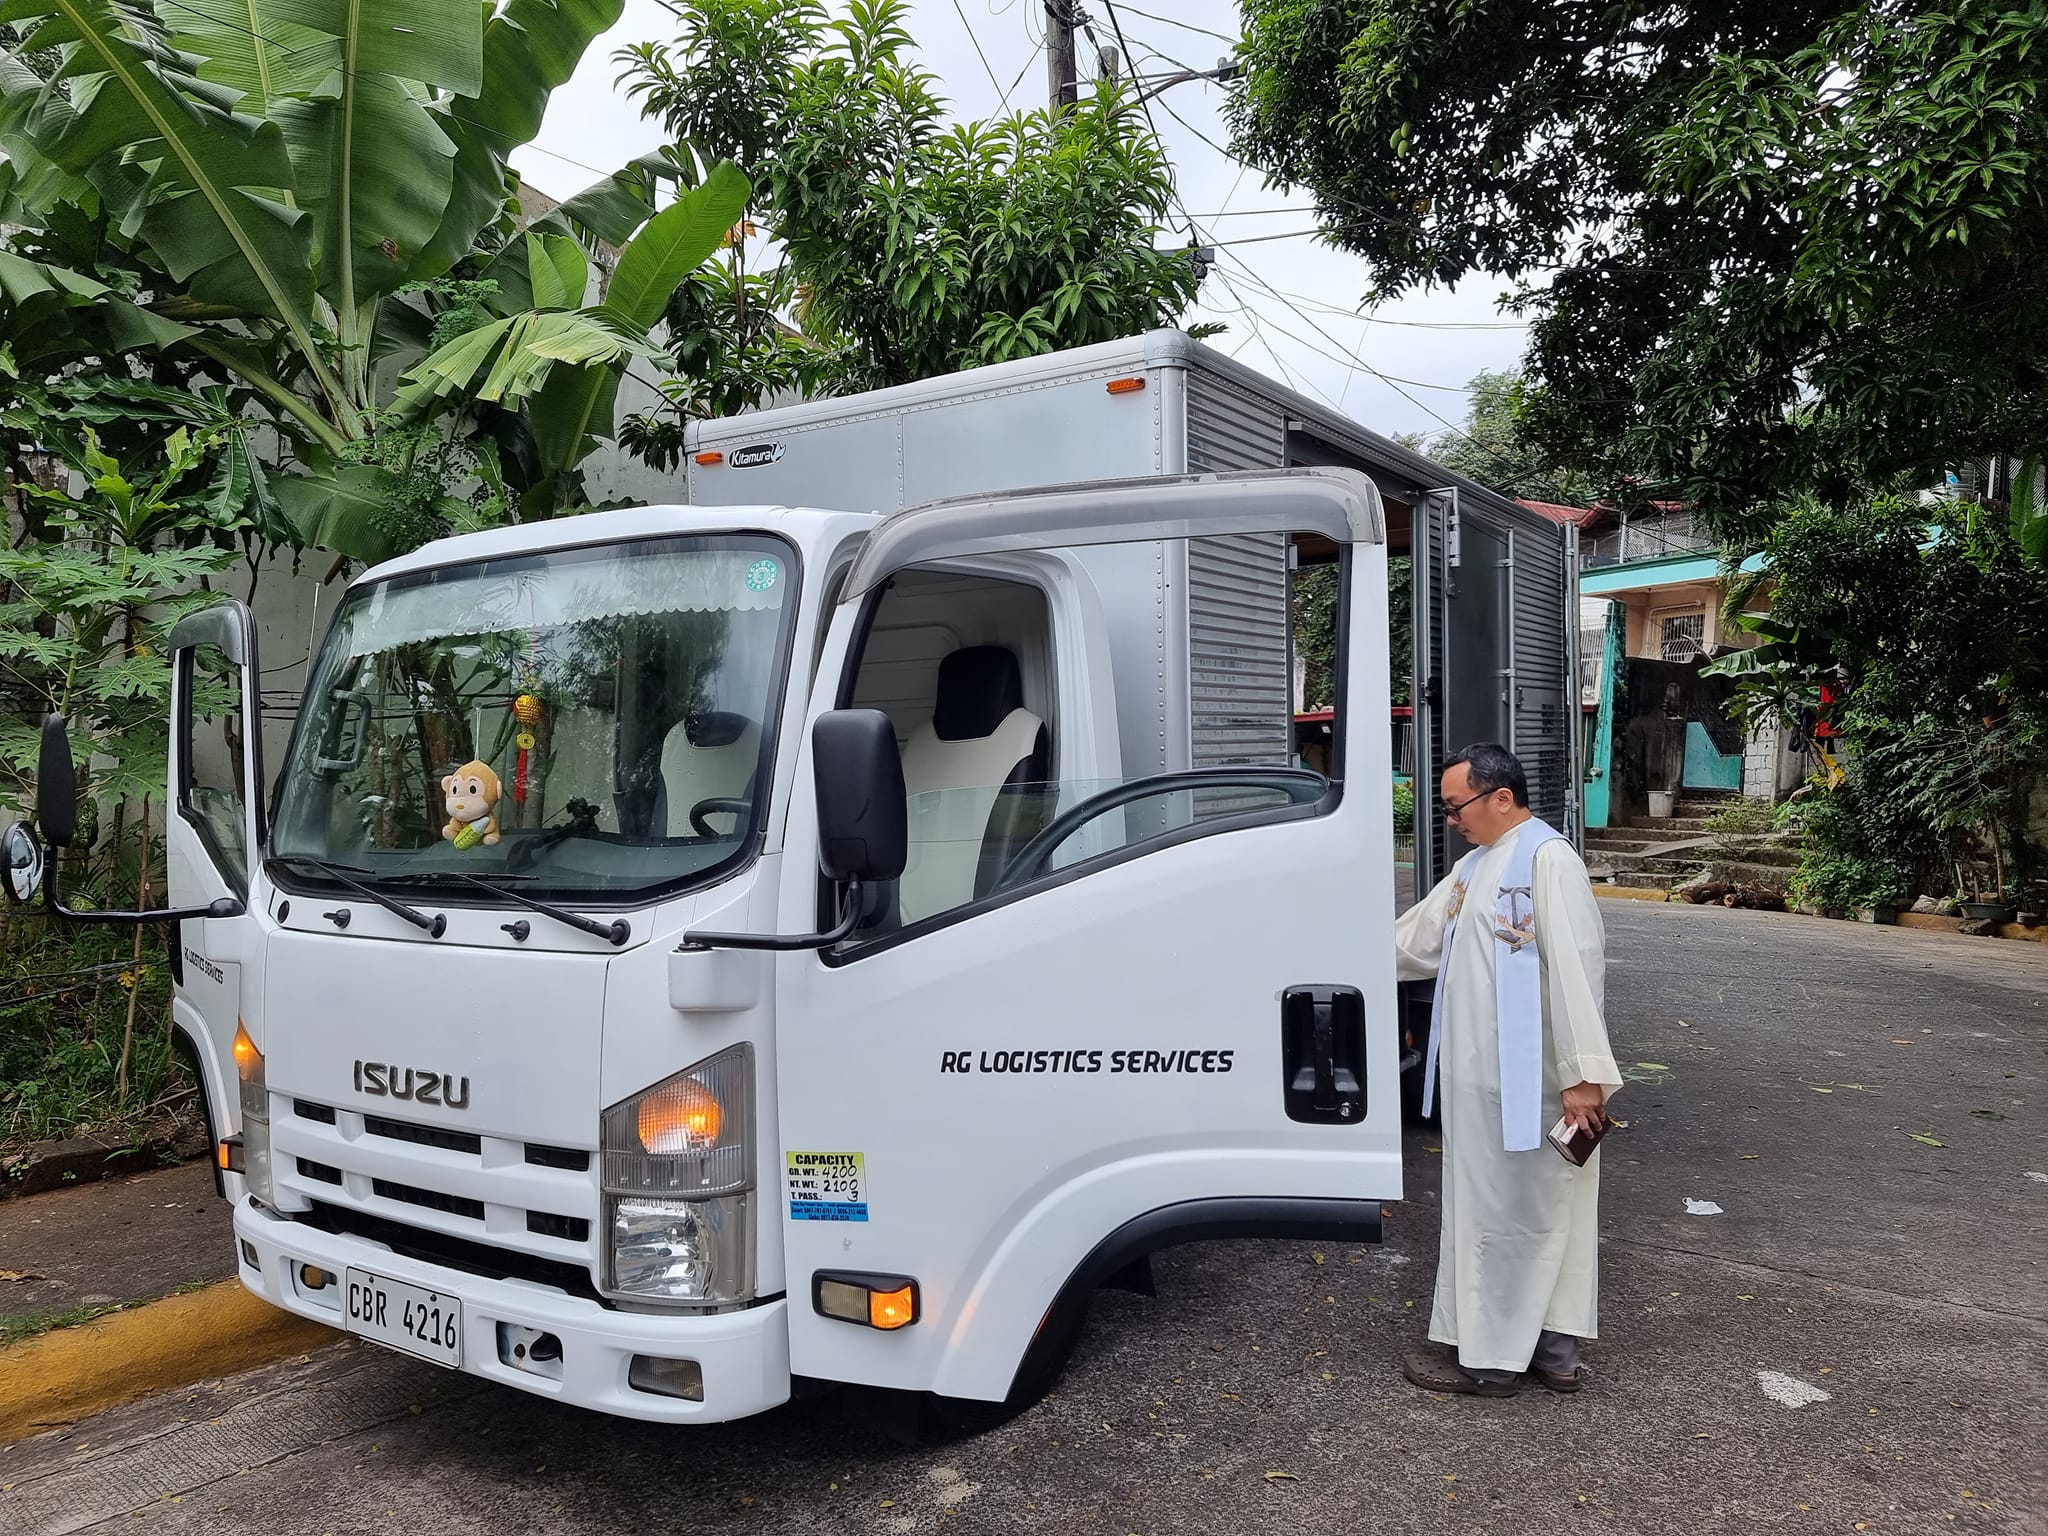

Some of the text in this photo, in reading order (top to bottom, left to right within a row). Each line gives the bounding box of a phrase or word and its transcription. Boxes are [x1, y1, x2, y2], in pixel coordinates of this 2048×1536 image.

[731, 450, 771, 466] Kitamura
[940, 1050, 1234, 1073] RG LOGISTICS SERVICES
[353, 1059, 471, 1110] ISUZU
[795, 1154, 854, 1165] CAPACITY
[822, 1165, 858, 1179] 4200
[823, 1178, 859, 1193] 2100
[349, 1282, 457, 1350] CBR 4216
